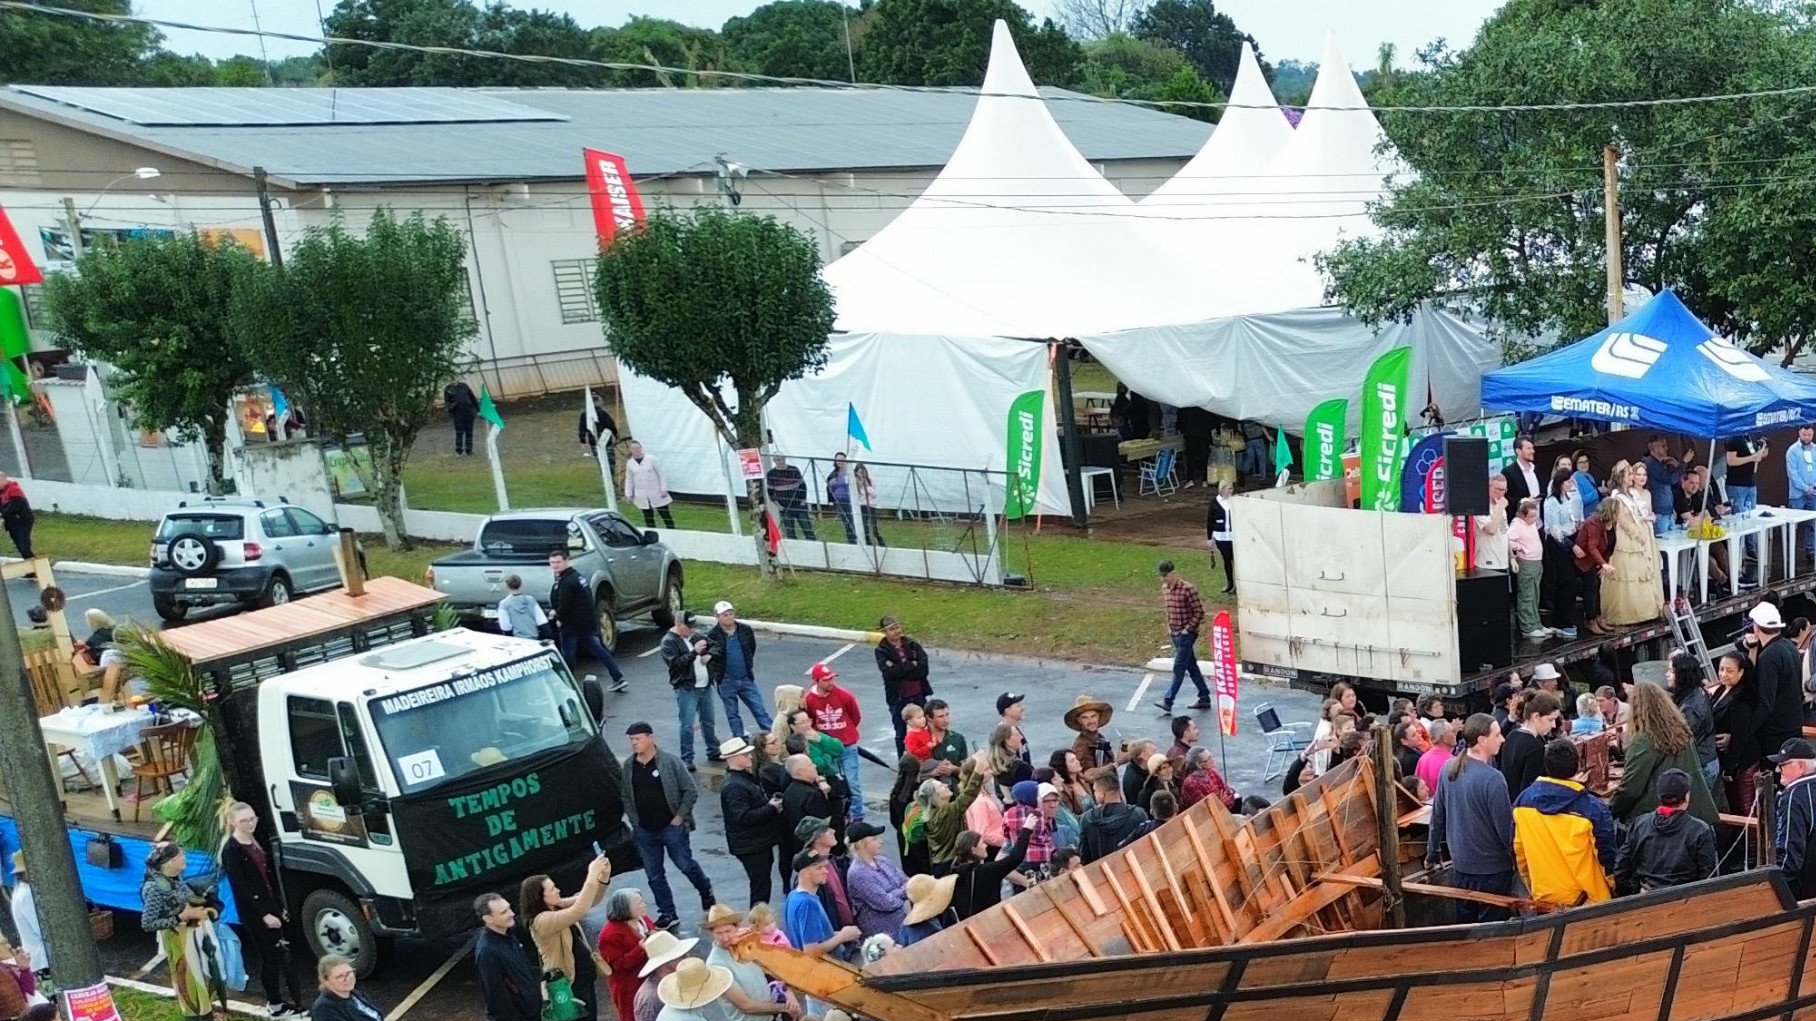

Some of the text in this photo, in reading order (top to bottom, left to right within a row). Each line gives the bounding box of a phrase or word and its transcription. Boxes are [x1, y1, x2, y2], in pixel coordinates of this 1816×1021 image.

[1018, 410, 1034, 480] Sicredi
[1316, 421, 1334, 480] icredi
[1377, 382, 1398, 482] Sicredi
[381, 654, 553, 715] MADEIREIRA IRMÃOS KAMPHORST
[1213, 625, 1227, 693] KAISER
[411, 760, 433, 779] 07
[448, 773, 541, 819] TEMPOS
[434, 809, 596, 885] ANTIGAMENTE
[485, 810, 518, 837] DE
